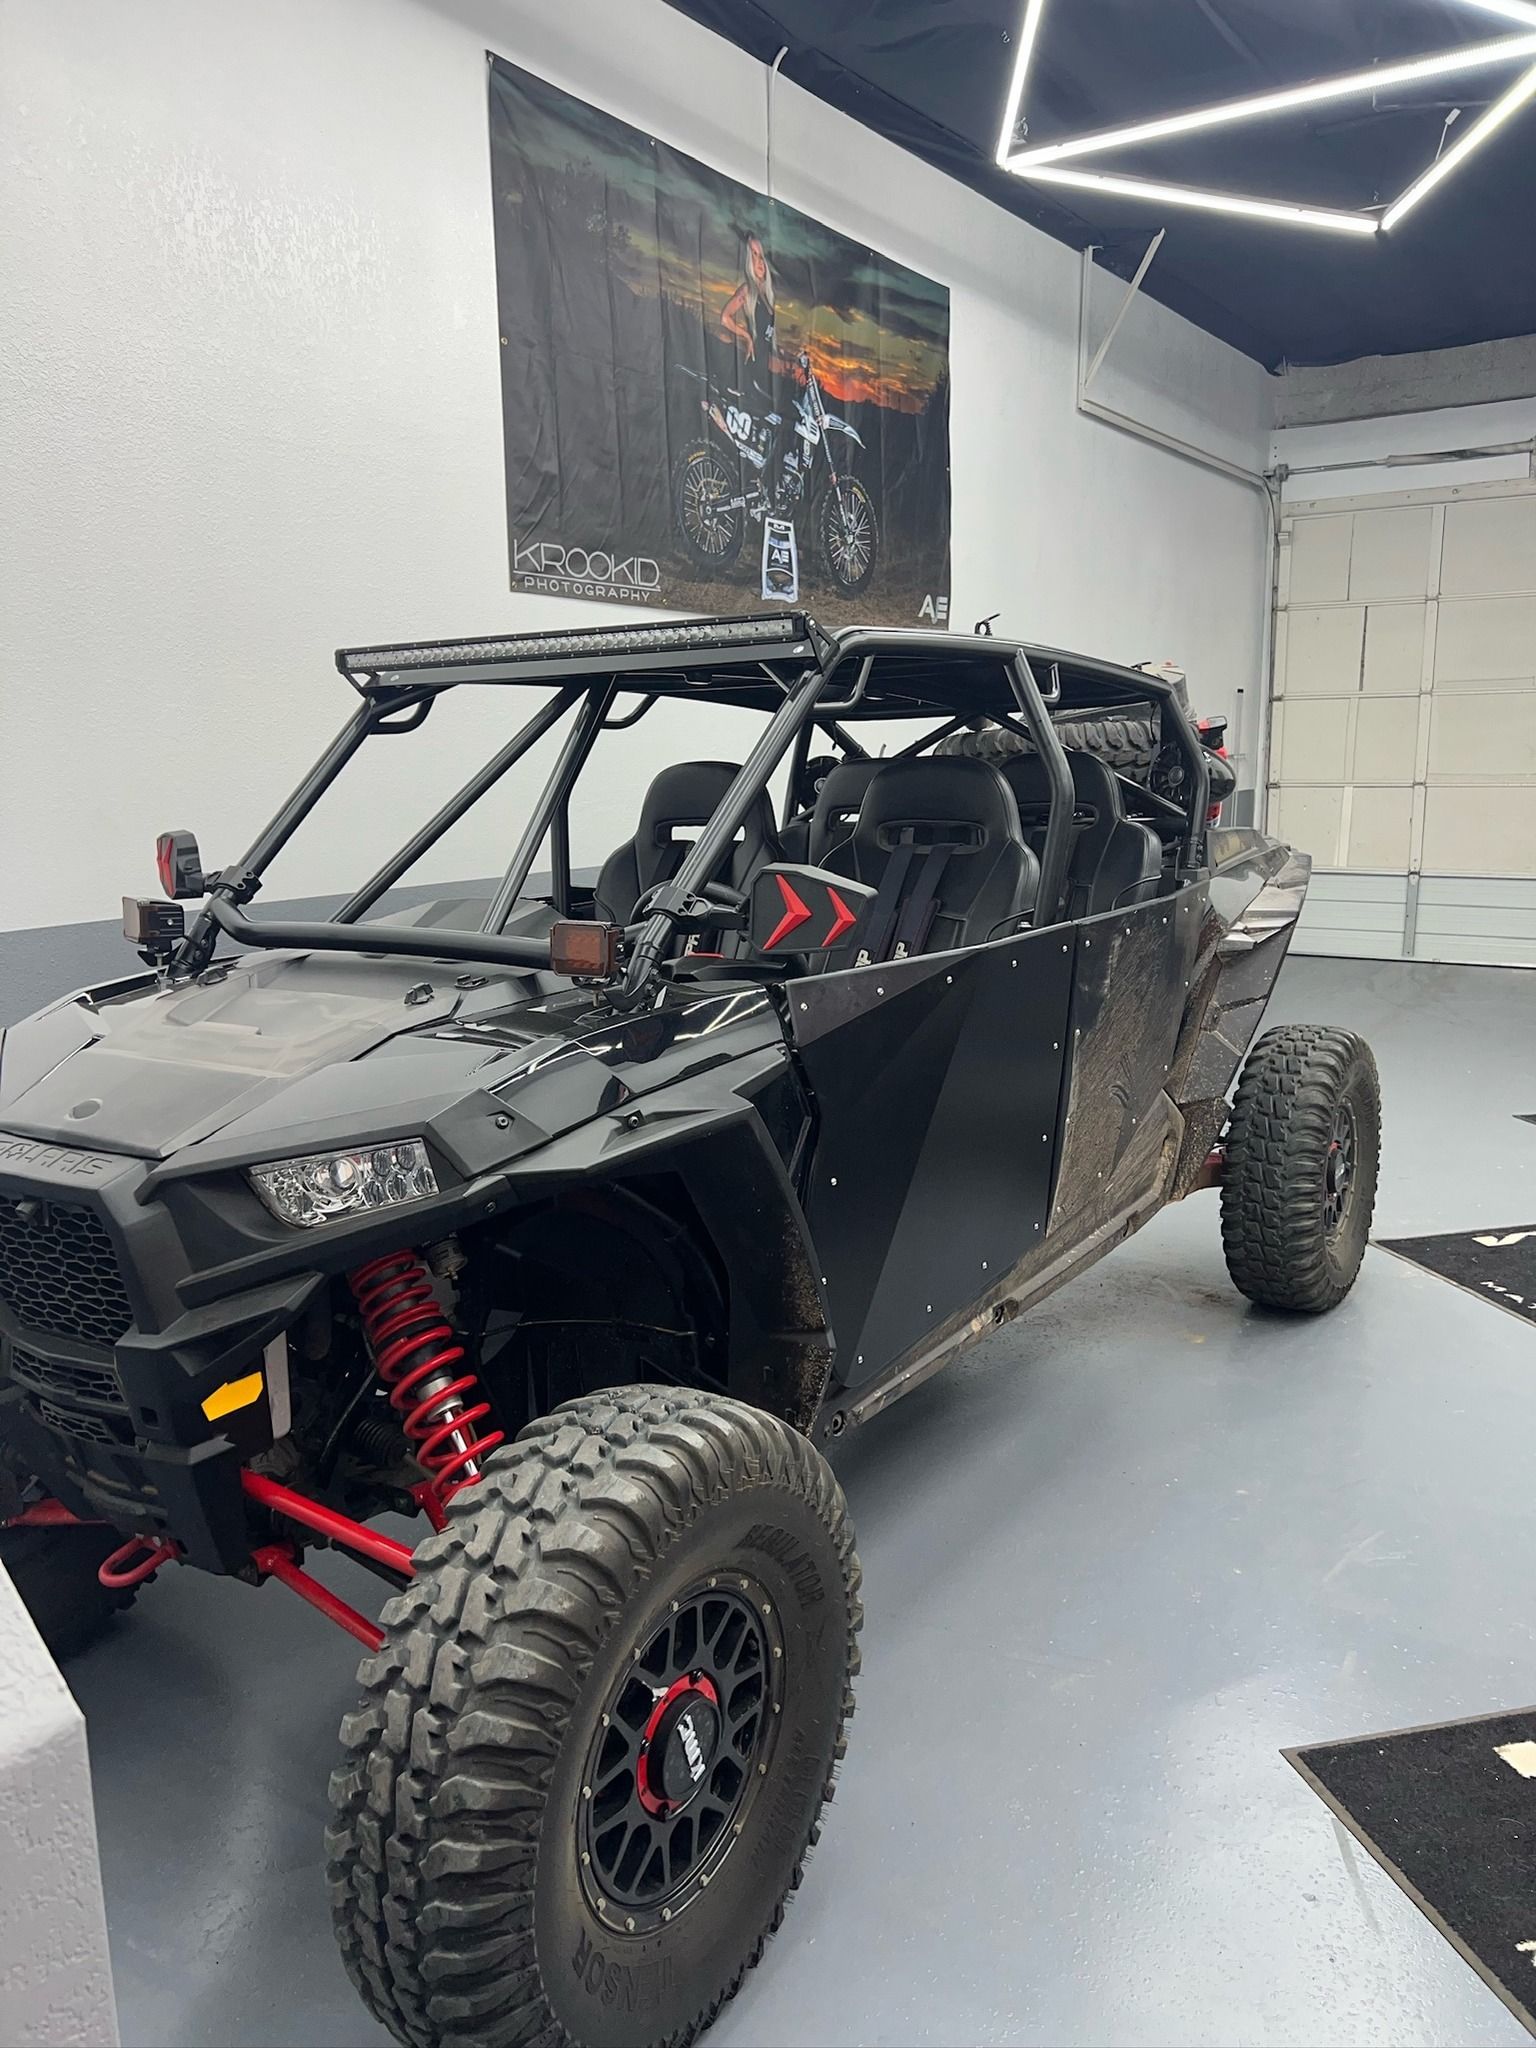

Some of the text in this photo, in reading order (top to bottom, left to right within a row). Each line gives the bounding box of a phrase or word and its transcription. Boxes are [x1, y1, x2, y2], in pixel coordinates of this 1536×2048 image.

[513, 539, 660, 588] KROOKID
[524, 576, 651, 602] PHOTOGRAPHY
[917, 593, 948, 625] AE
